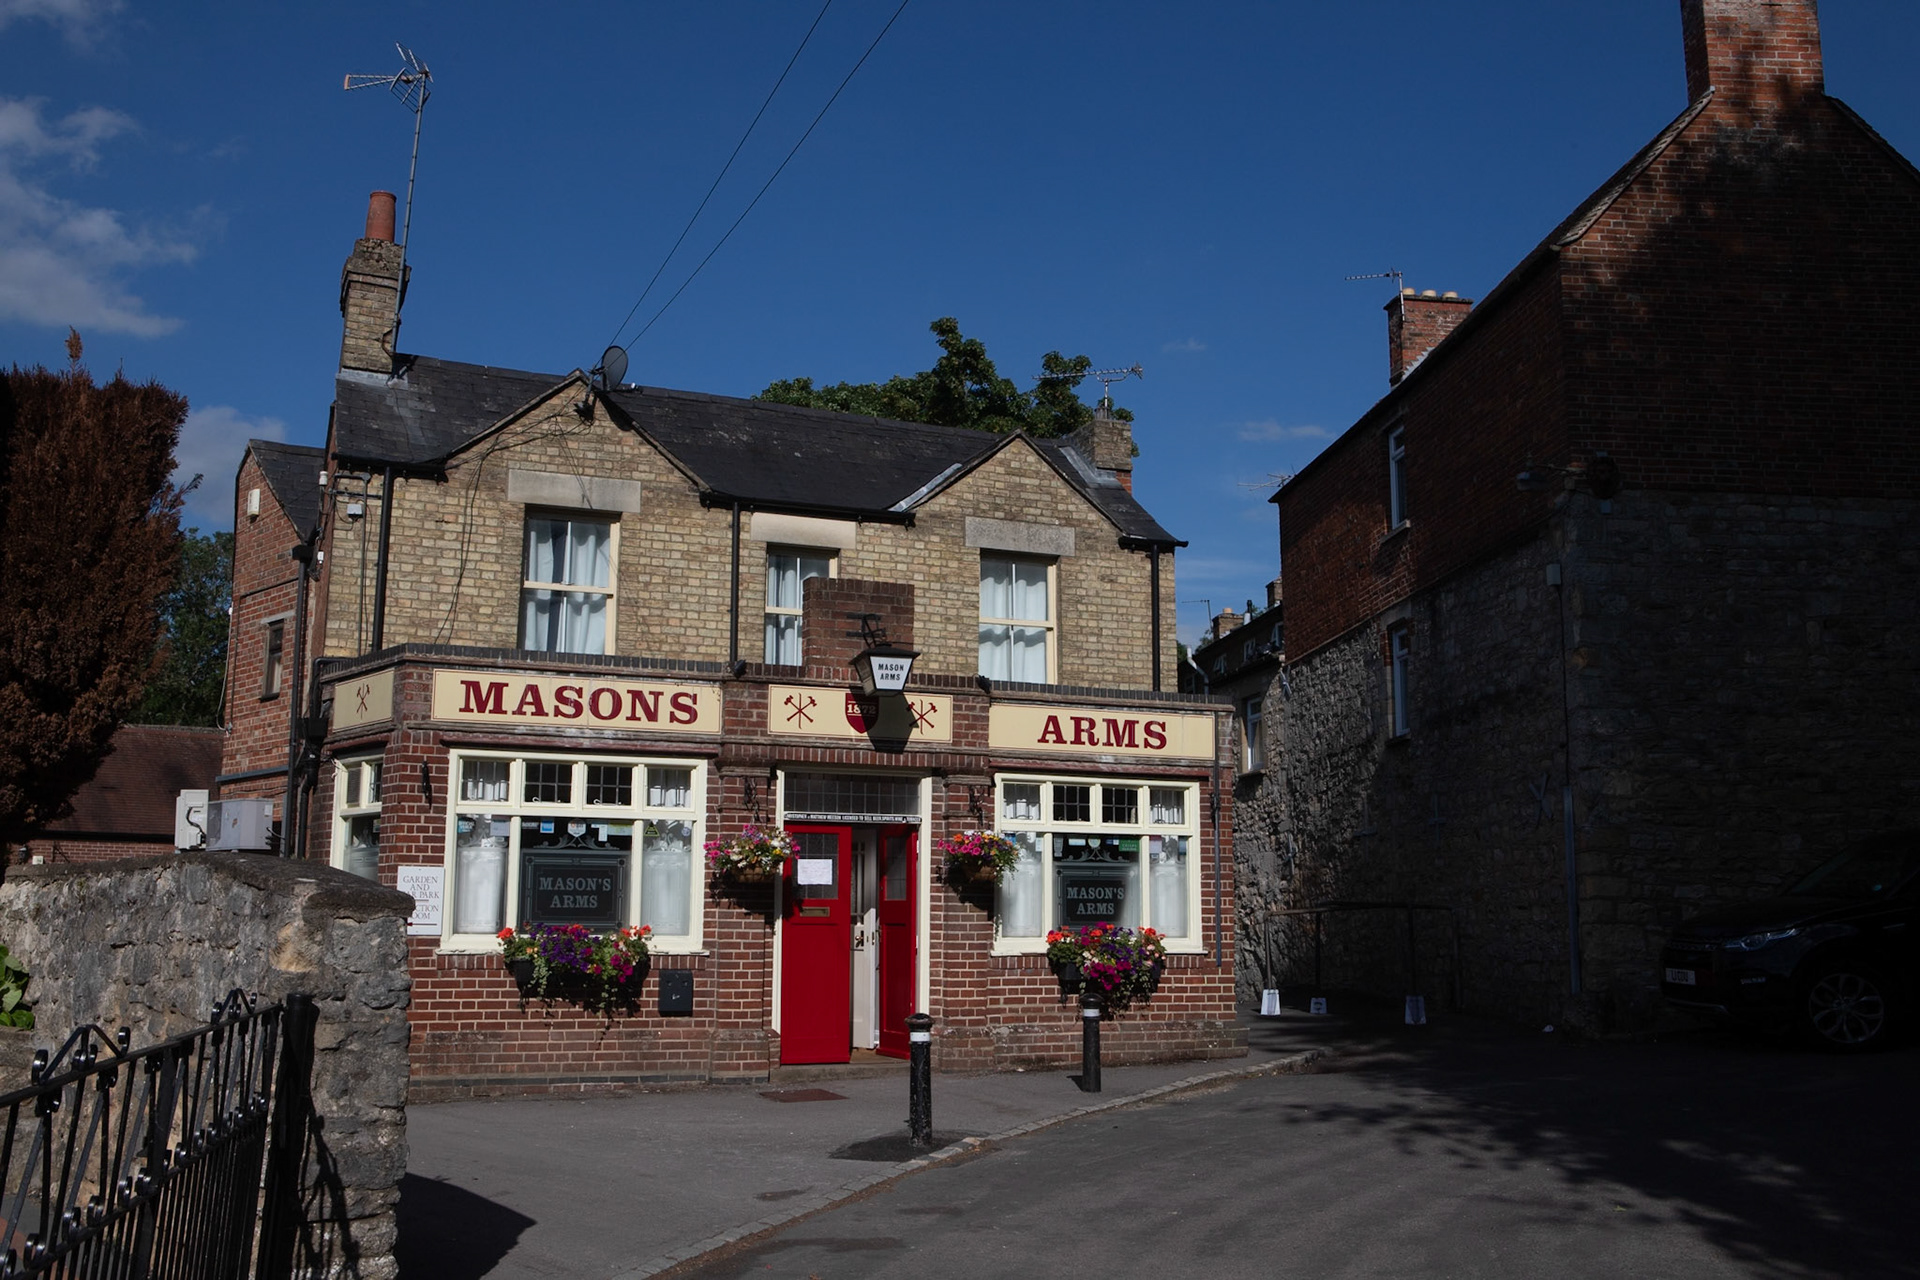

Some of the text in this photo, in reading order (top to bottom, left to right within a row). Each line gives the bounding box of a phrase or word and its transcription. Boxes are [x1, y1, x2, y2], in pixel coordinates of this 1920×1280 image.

[877, 663, 904, 672] MASON
[880, 673, 901, 681] ARMS
[458, 679, 699, 725] MASONS
[847, 704, 876, 714] 1872
[1037, 714, 1167, 750] ARMS
[539, 877, 611, 891] MASON'S
[419, 891, 440, 899] PARK
[1066, 886, 1125, 900] MASON'S
[550, 895, 598, 909] ARMS
[416, 904, 439, 912] CTION
[1076, 902, 1115, 915] ARMS
[411, 912, 431, 920] OOM
